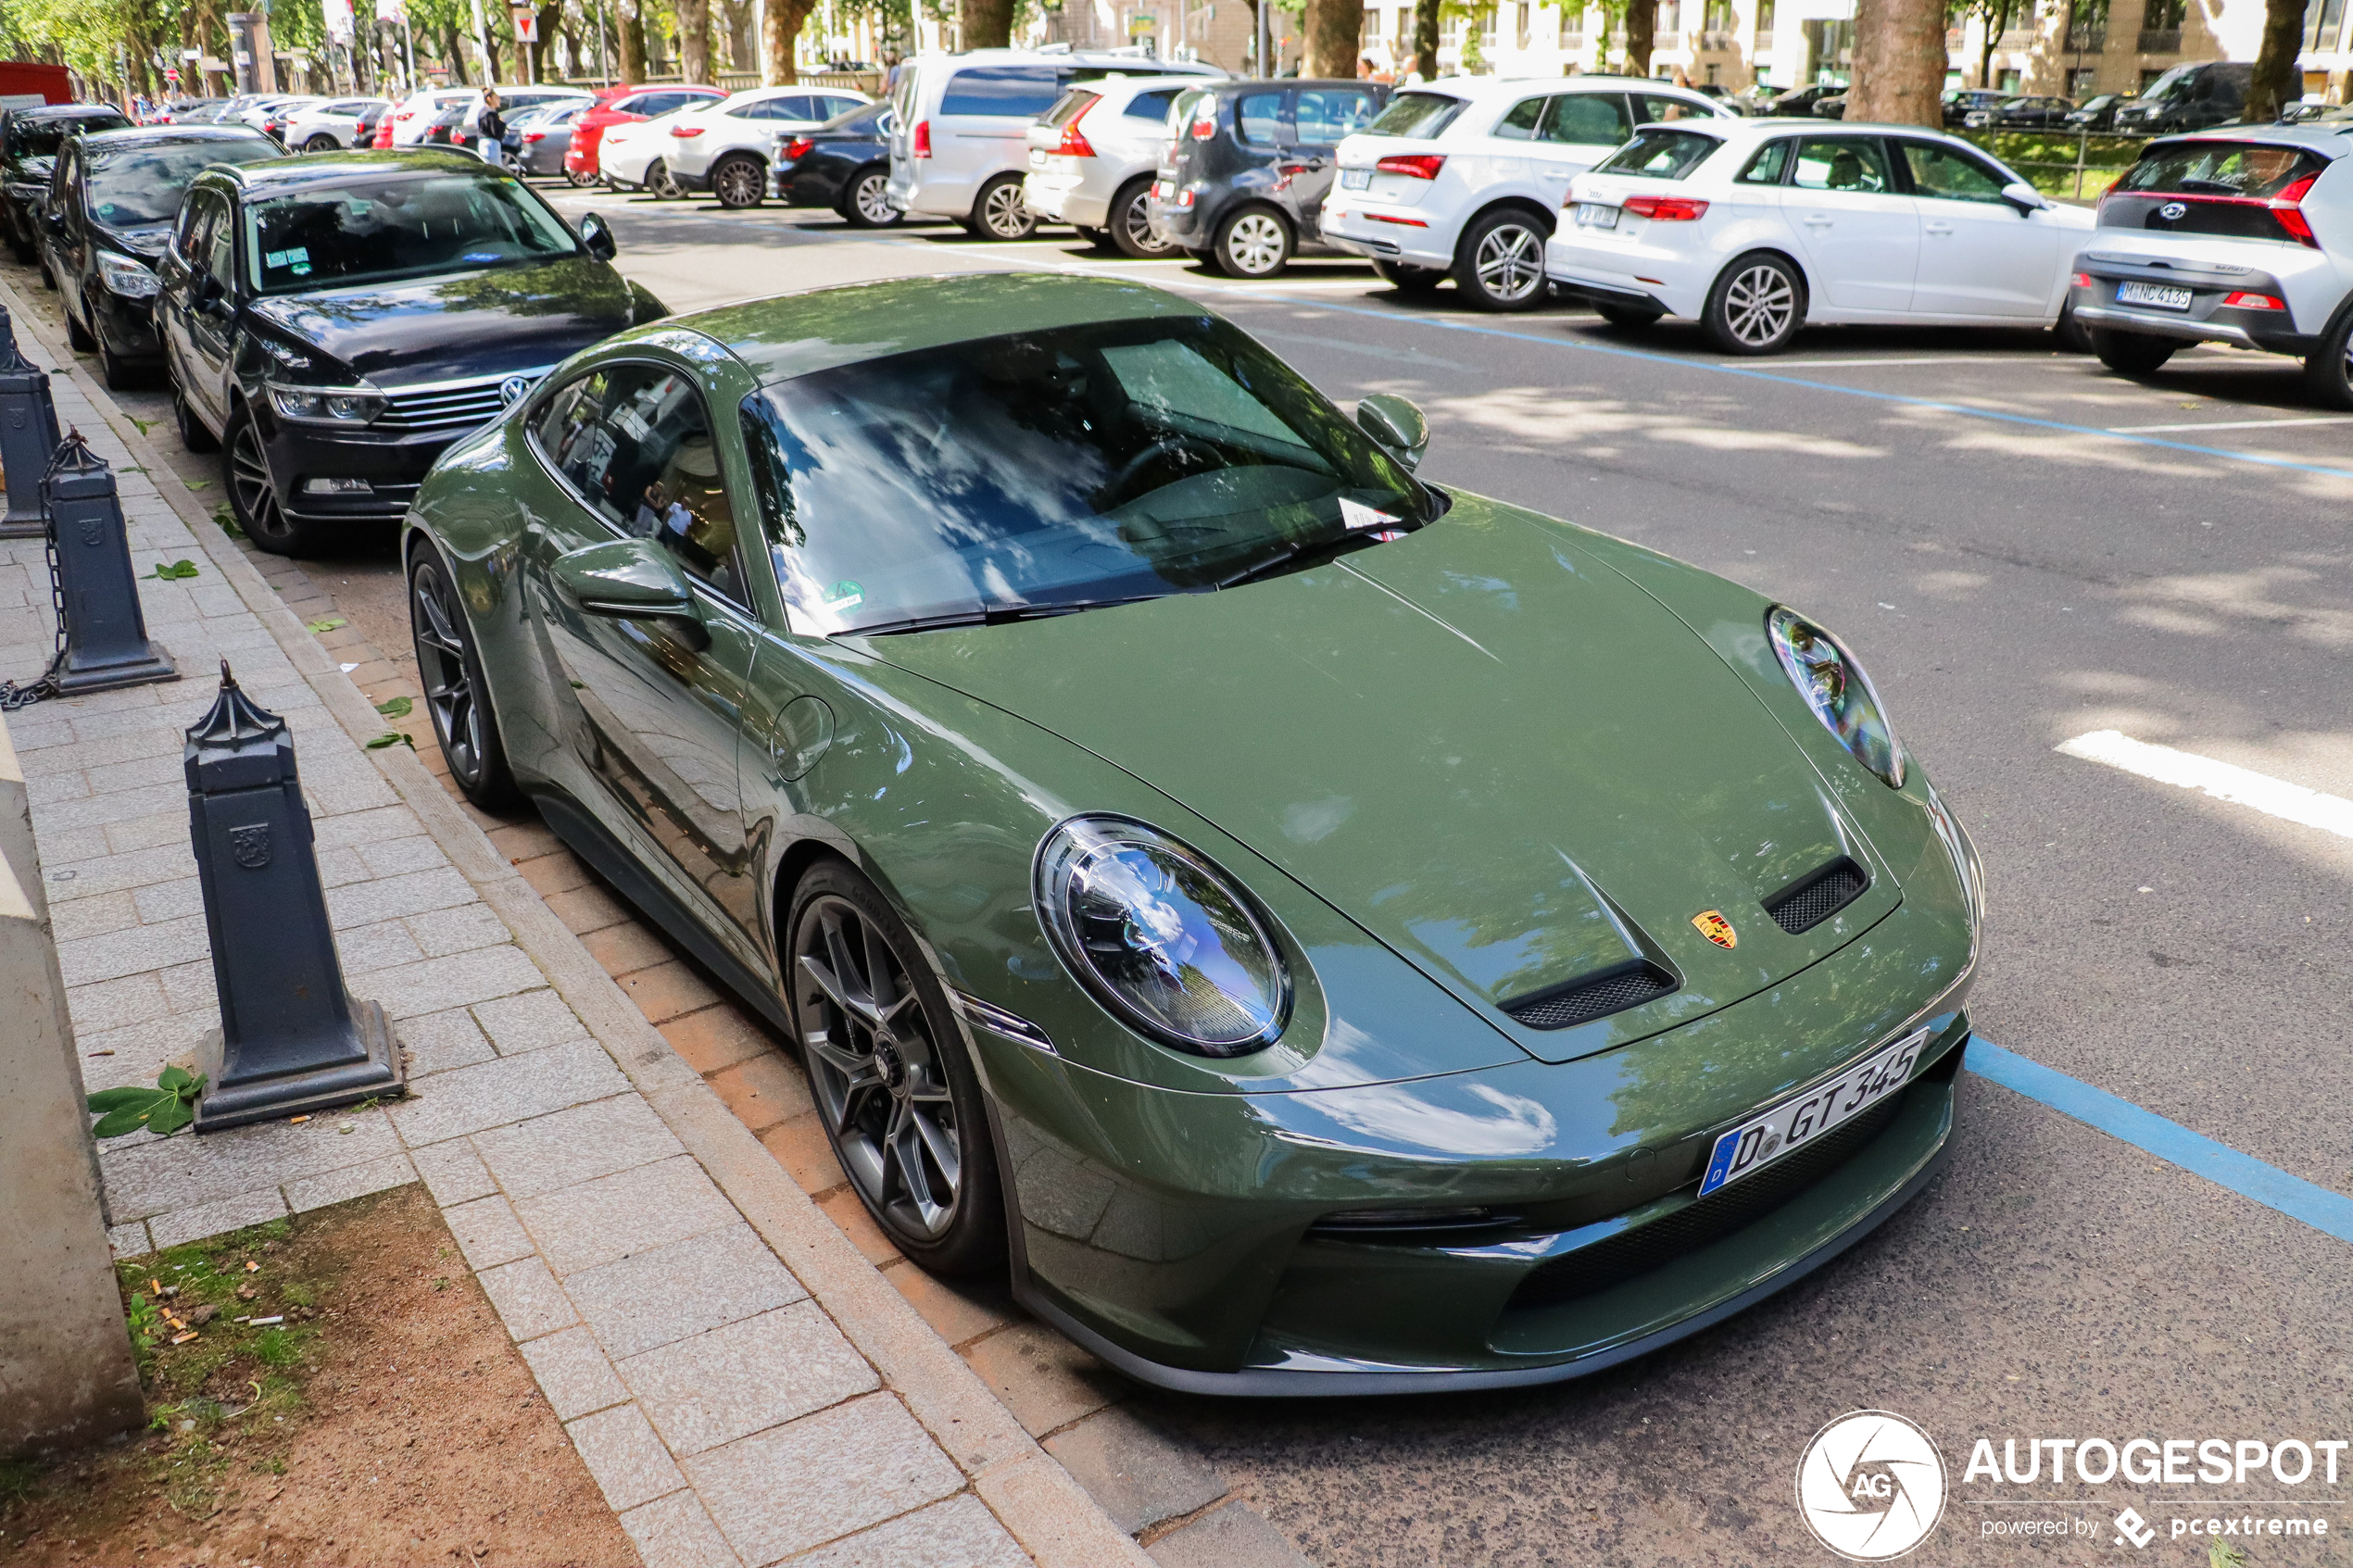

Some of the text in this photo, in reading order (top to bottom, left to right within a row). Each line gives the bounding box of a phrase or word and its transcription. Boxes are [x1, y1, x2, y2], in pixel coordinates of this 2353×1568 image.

[2124, 282, 2188, 305] M NC 4135
[836, 583, 848, 597] 4
[1209, 917, 1251, 940] PORSCHE
[1729, 1039, 1921, 1175] D GT 345
[1711, 1168, 1722, 1183] D
